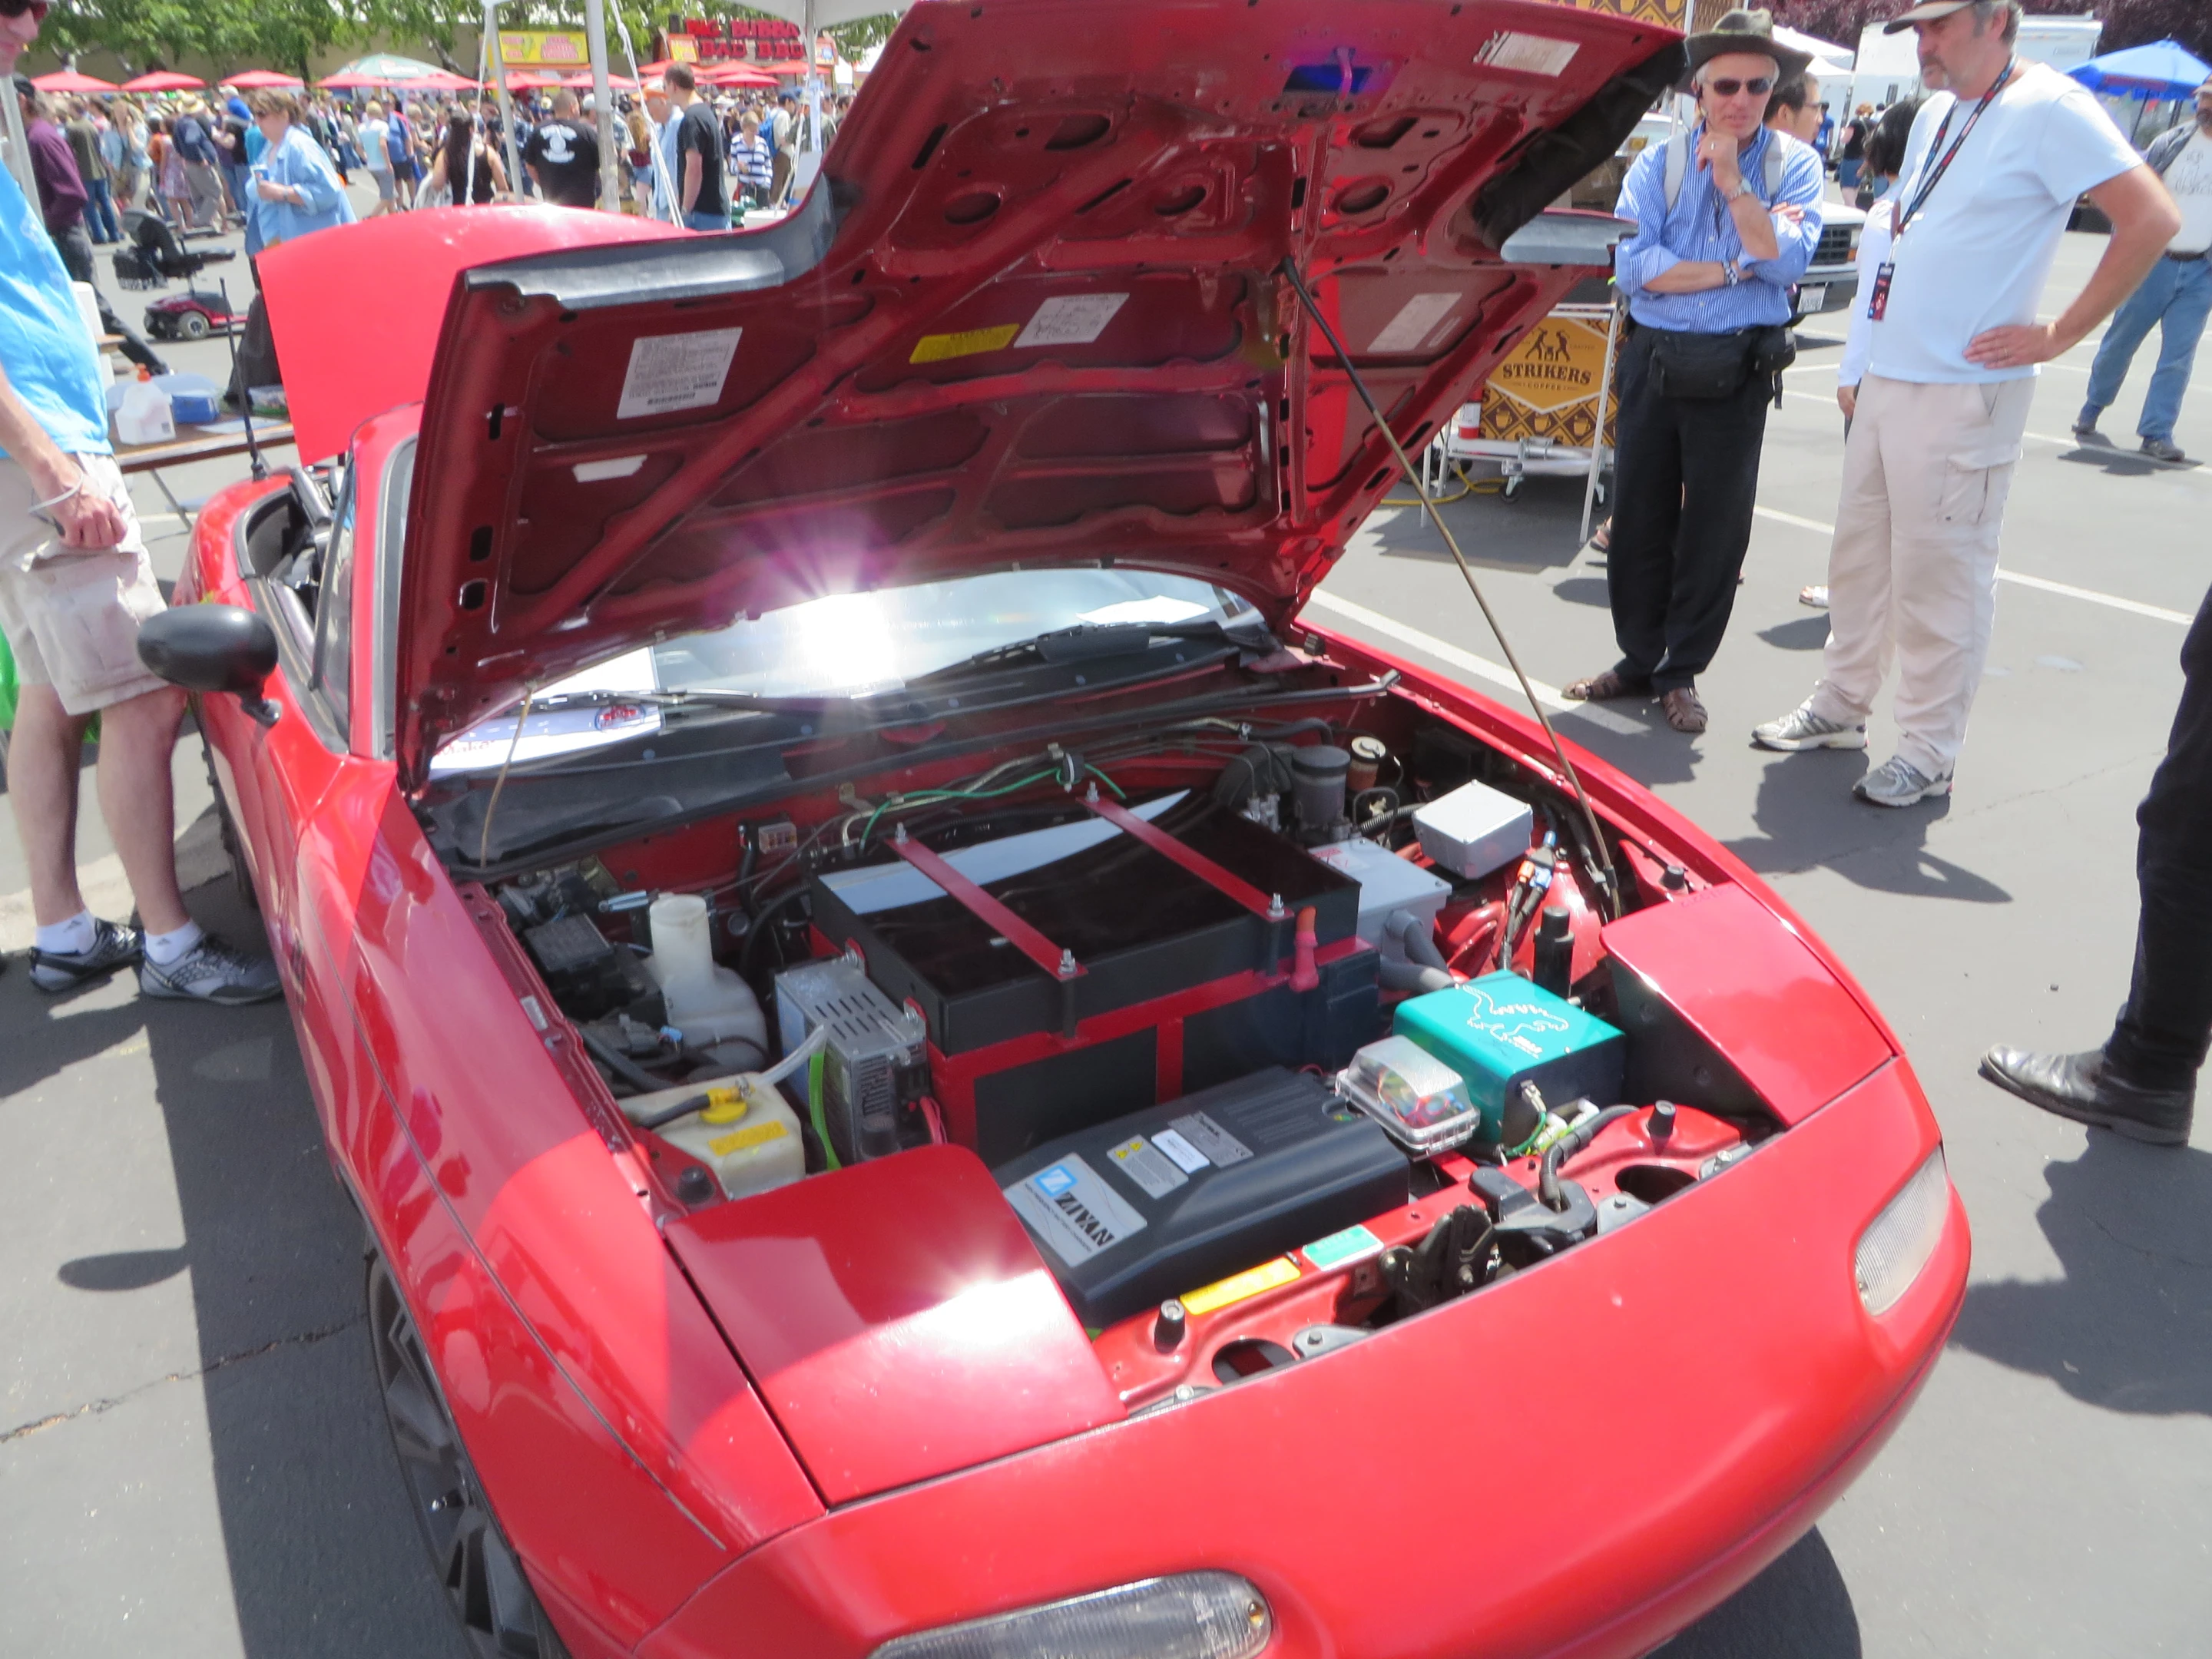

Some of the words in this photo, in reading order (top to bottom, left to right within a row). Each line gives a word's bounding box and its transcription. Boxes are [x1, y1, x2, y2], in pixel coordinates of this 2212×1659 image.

[1503, 363, 1592, 385] STRIKERS
[1526, 383, 1561, 392] COFFEE
[1055, 1190, 1115, 1247] ZIVAN
